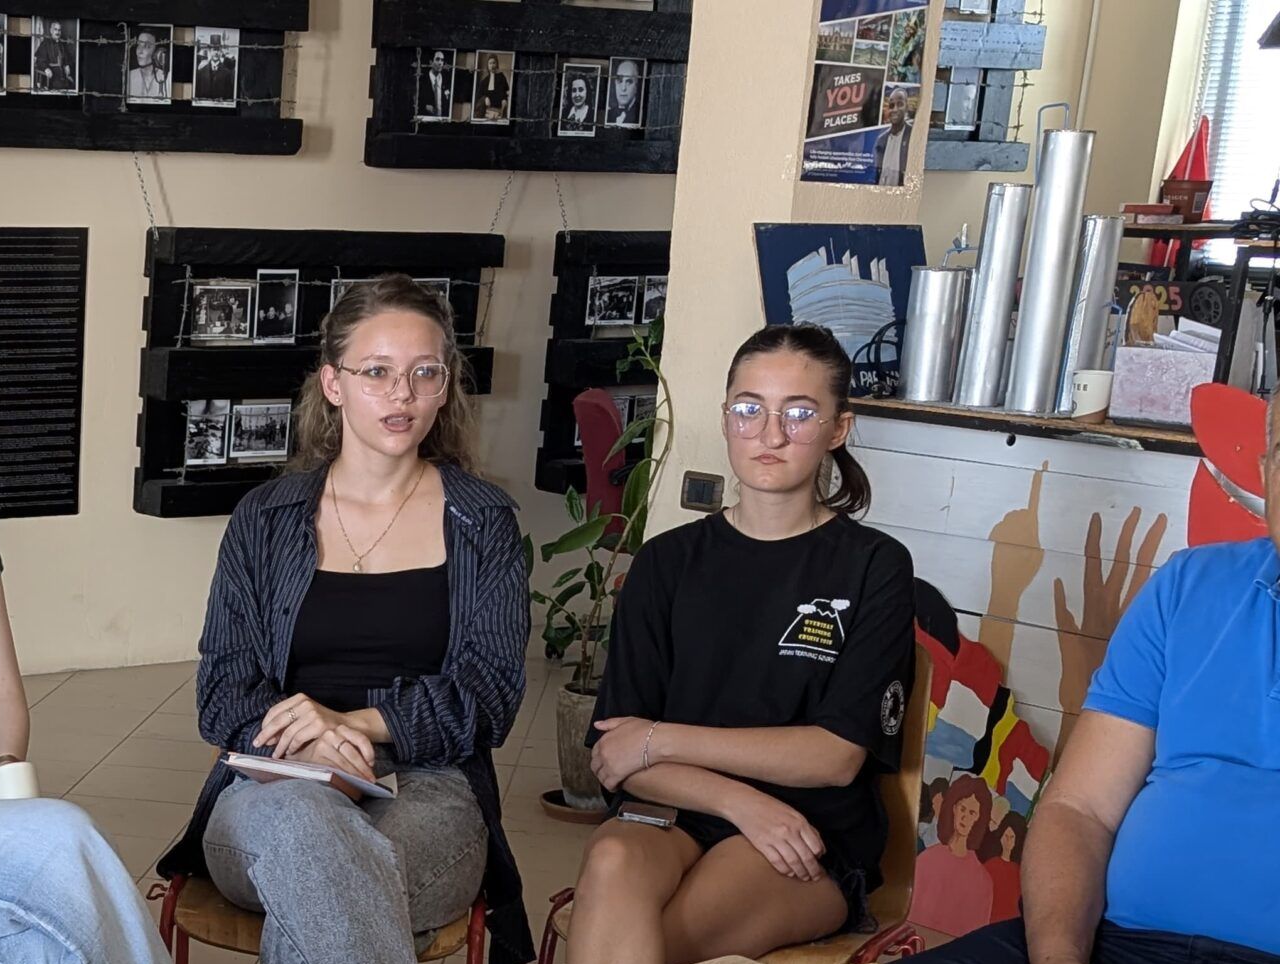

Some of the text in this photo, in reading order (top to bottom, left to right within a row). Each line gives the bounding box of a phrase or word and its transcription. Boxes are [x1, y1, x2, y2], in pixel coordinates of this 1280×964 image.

[833, 73, 862, 86] TAKES
[826, 83, 866, 108] YOU
[824, 113, 859, 128] PLACES
